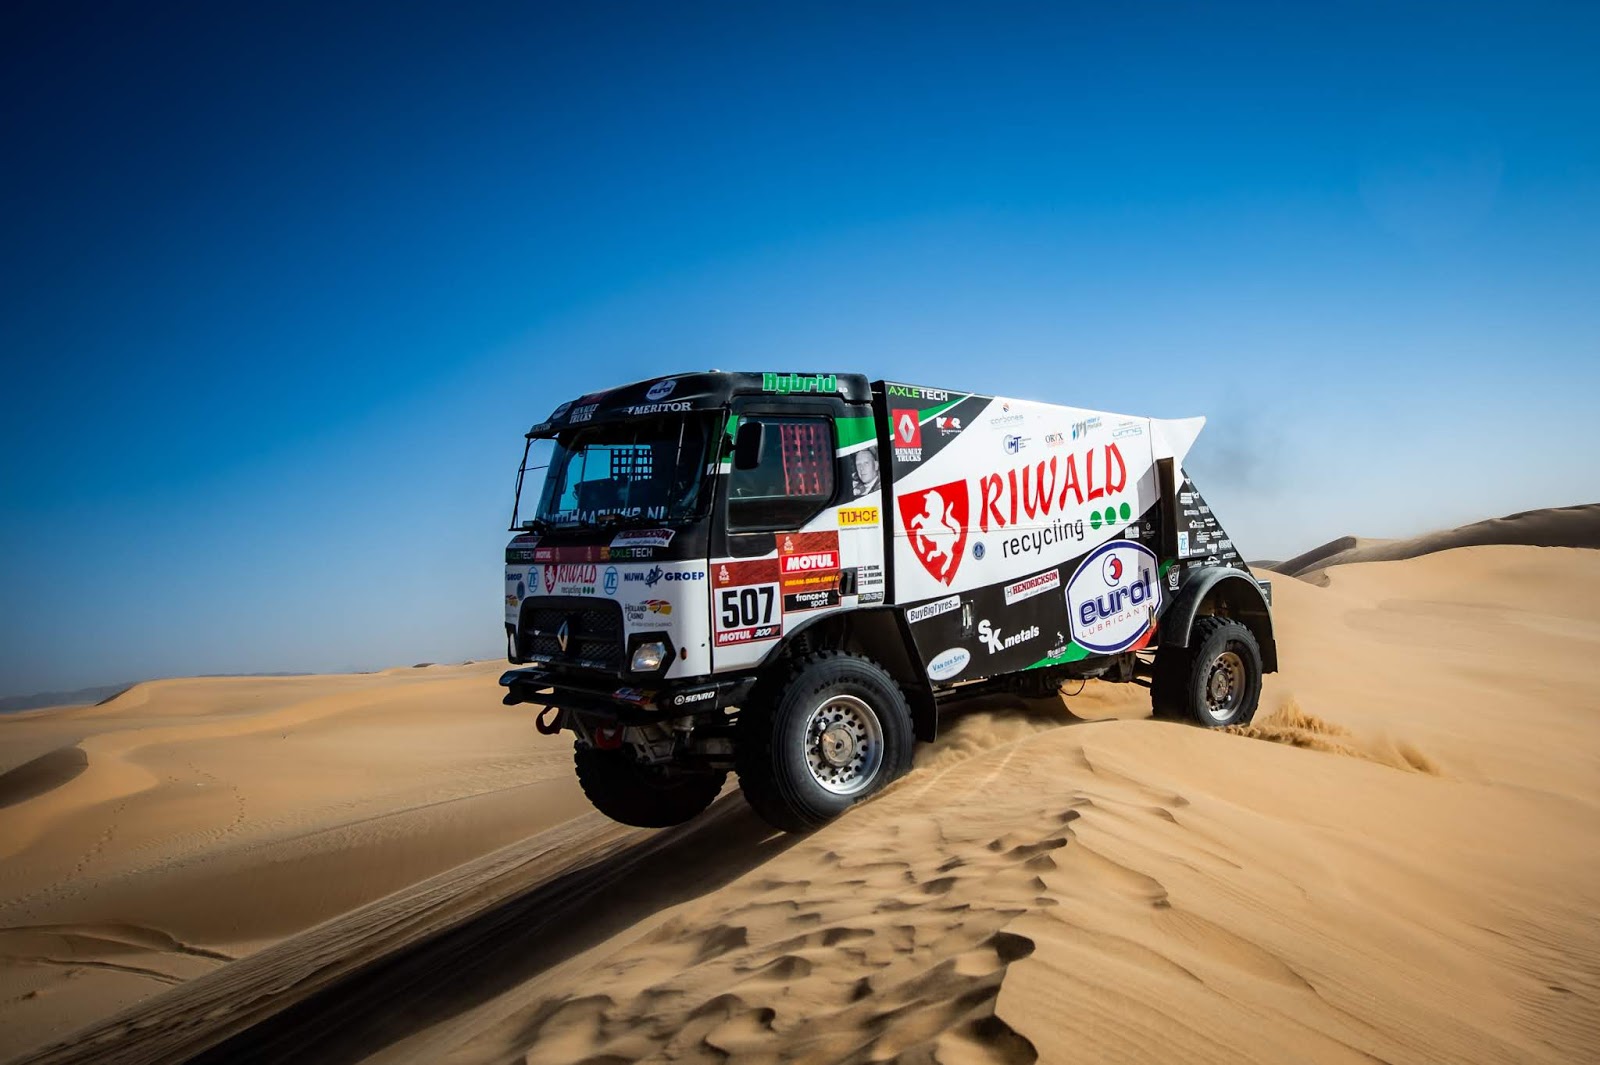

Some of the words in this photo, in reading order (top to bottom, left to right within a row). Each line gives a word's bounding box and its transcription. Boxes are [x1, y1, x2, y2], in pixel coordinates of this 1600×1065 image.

[763, 372, 836, 394] Hybrid
[888, 385, 949, 401] AXLETECH
[634, 402, 692, 415] MERITOR
[569, 412, 593, 424] TRUCKS
[979, 442, 1127, 534] RIWALD
[1002, 518, 1084, 558] recycling
[610, 547, 652, 558] AXLETECH
[786, 554, 834, 571] MOTUL
[558, 565, 597, 584] RIWALD
[623, 572, 644, 582] NIJWA
[664, 571, 705, 581] GROEP
[1012, 571, 1058, 595] HENDRICKSON
[810, 598, 828, 608] sport
[1079, 567, 1152, 627] eurol
[722, 586, 774, 629] 507
[719, 630, 751, 642] MOTUL
[978, 619, 1005, 655] SK
[1005, 625, 1040, 649] metals
[932, 663, 944, 672] VAN
[684, 691, 715, 704] SENRO
